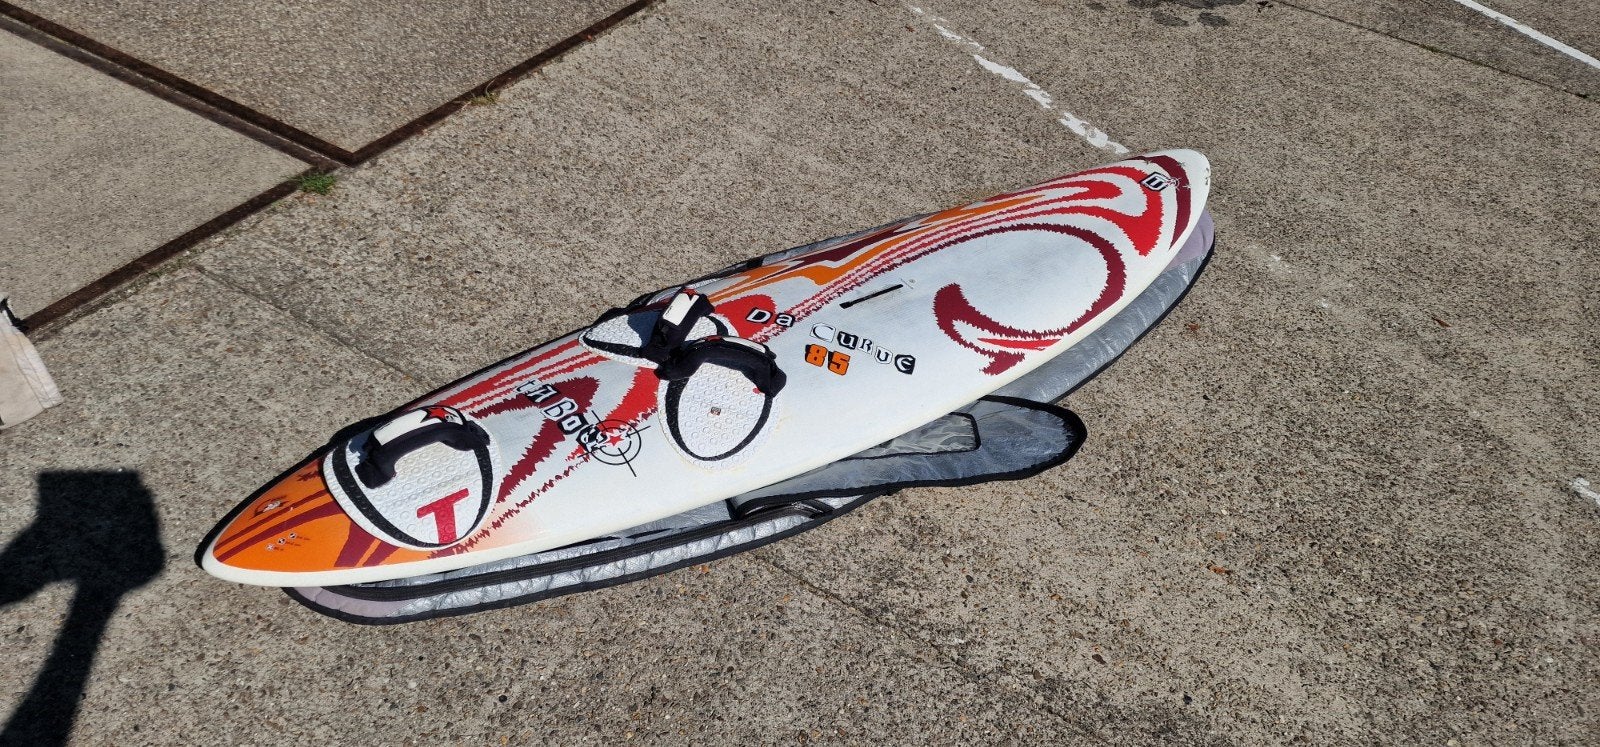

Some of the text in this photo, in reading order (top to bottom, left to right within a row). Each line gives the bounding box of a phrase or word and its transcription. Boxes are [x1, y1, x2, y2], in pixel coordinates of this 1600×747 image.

[746, 307, 795, 327] Da
[805, 343, 850, 376] 85
[416, 487, 470, 544] T
